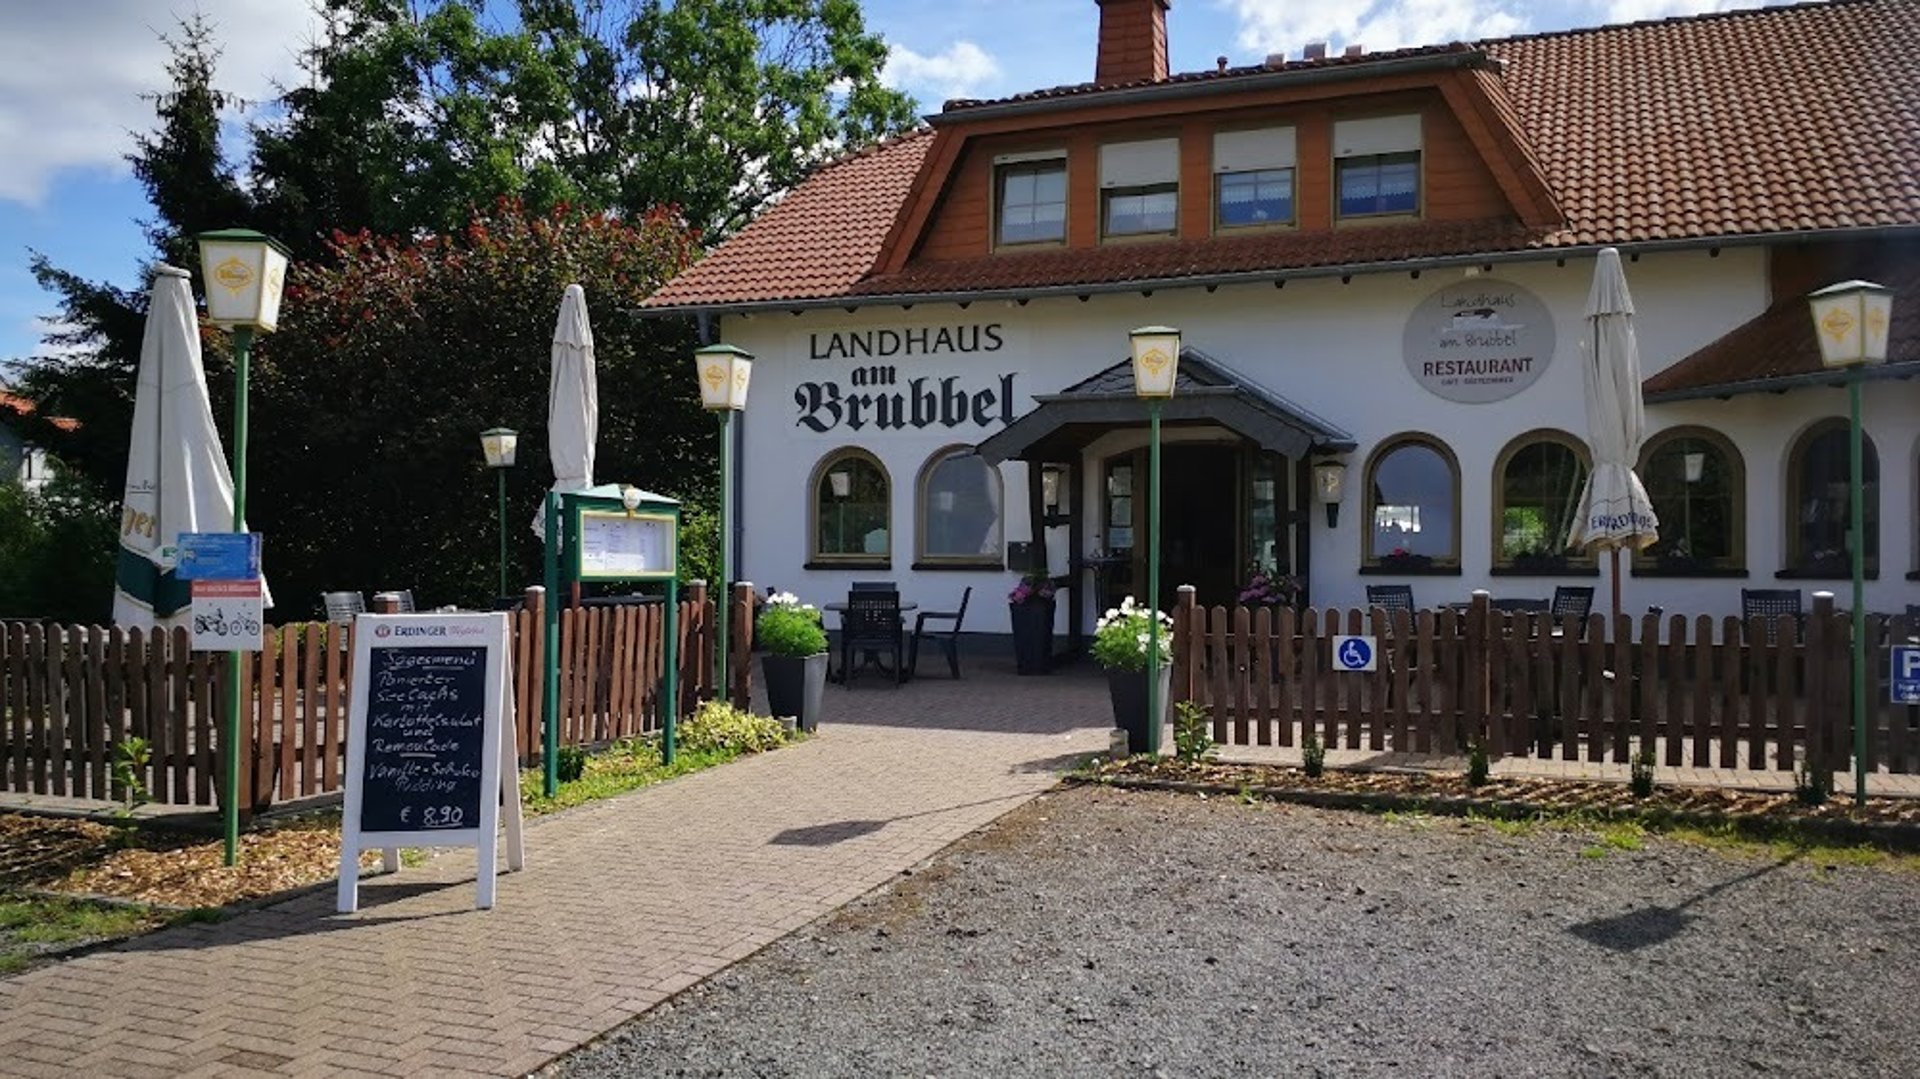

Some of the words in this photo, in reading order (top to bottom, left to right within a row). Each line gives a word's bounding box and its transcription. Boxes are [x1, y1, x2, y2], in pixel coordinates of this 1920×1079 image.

[810, 323, 1003, 360] LANDHAUS
[851, 365, 896, 387] am
[1423, 357, 1534, 377] RESTAURANT
[794, 372, 1018, 433] Brubbel
[394, 625, 448, 637] ERDINGER
[400, 806, 412, 823] €
[423, 805, 464, 826] 8,90
